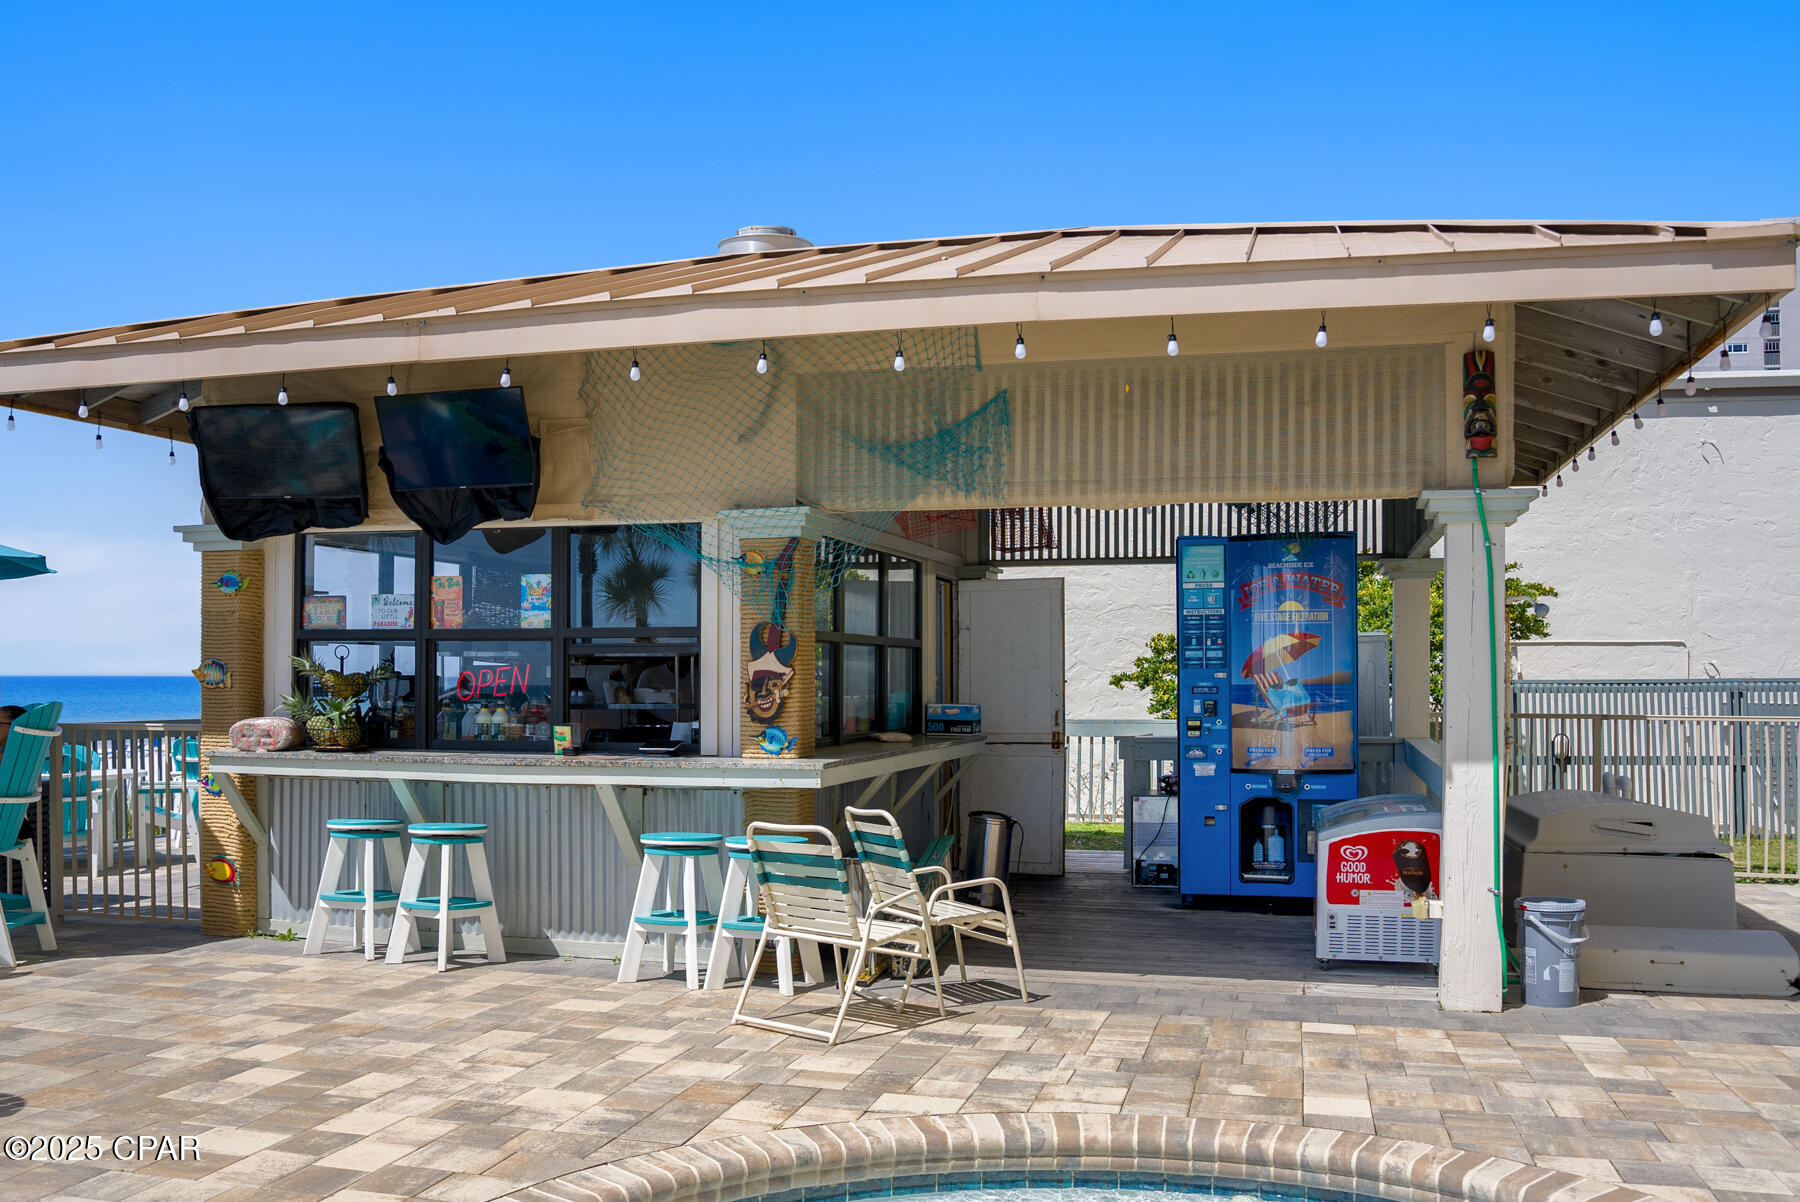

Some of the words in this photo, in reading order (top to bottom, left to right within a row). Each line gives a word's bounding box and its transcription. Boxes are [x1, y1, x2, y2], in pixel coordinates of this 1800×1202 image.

[1243, 579, 1269, 597] ICE
[1272, 576, 1284, 588] &
[1286, 574, 1341, 595] WATER
[383, 595, 414, 607] Welcome
[1254, 612, 1269, 622] FIVE
[1270, 612, 1291, 622] STAGE
[1292, 611, 1329, 622] FILTRATION
[457, 663, 530, 701] OPEN
[928, 722, 945, 732] 500
[1340, 861, 1367, 873] GOOD
[1336, 872, 1371, 884] HUMOR
